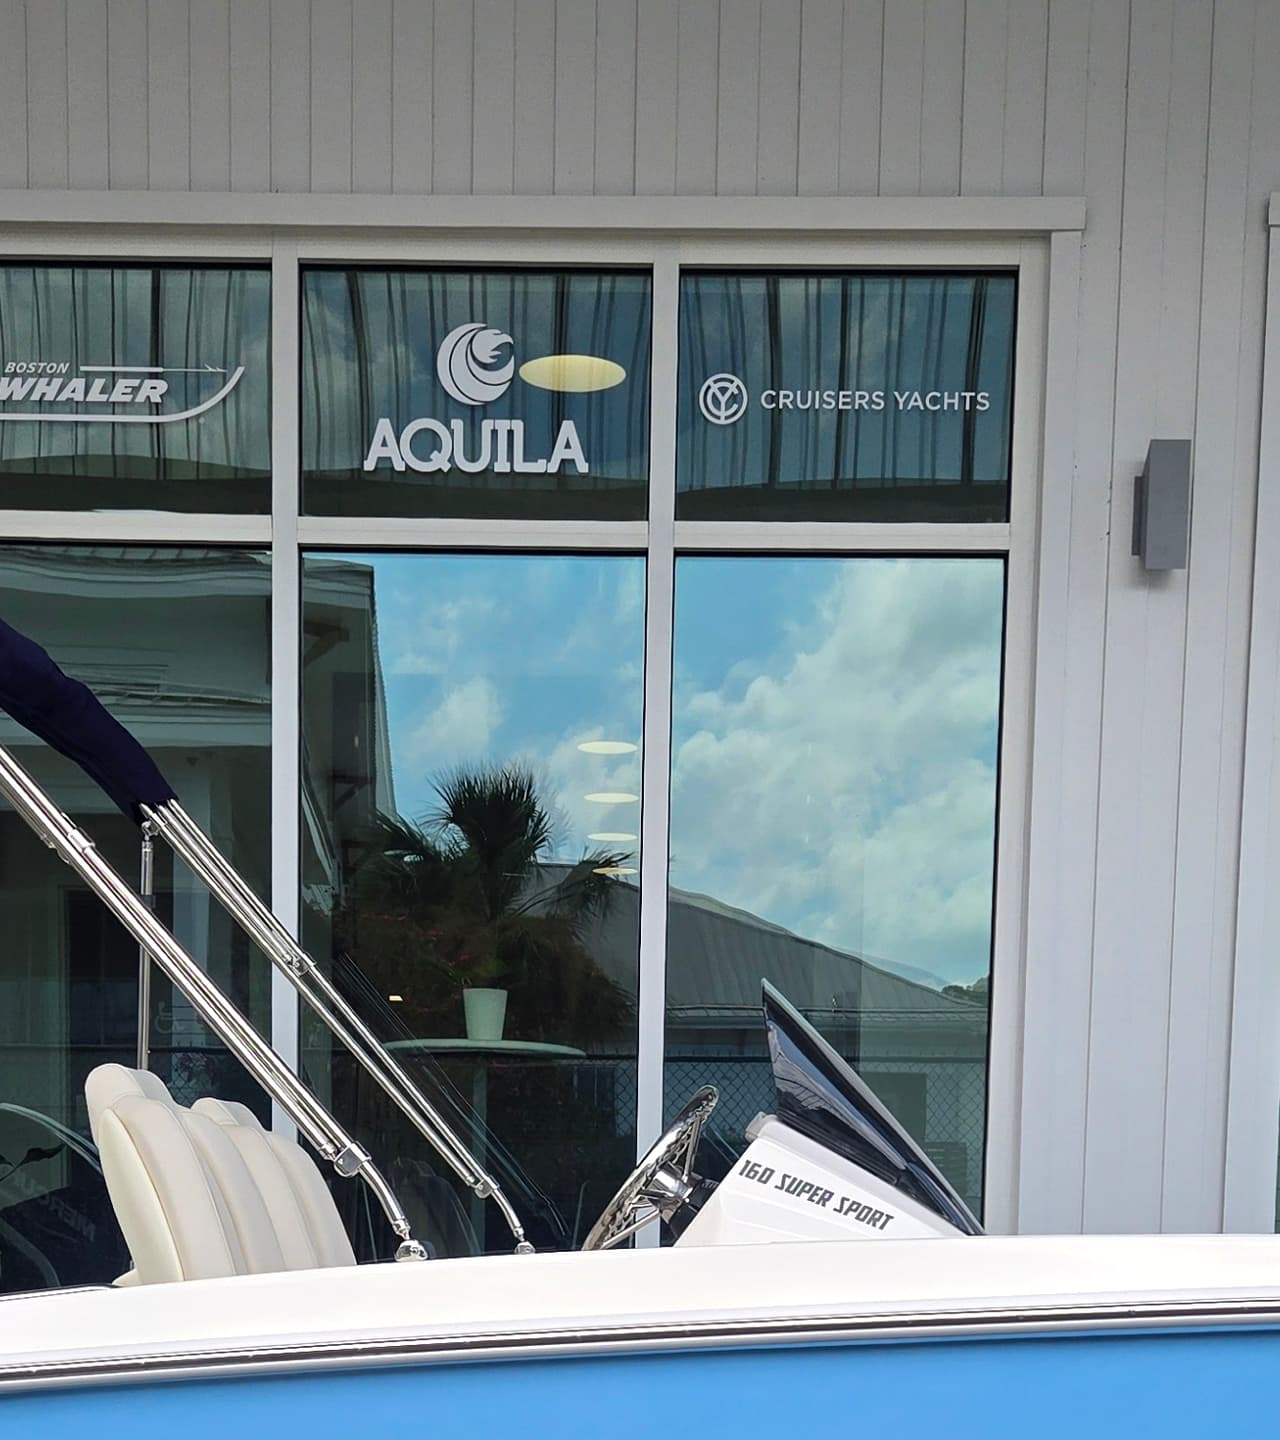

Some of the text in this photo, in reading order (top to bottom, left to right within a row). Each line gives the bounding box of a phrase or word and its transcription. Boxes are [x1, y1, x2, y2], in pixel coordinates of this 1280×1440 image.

[4, 362, 70, 375] BOSTON
[760, 390, 991, 411] CRUISERS YACHTS
[363, 417, 589, 473] AQUILA
[738, 1159, 895, 1231] 160 SUPER SPORT
